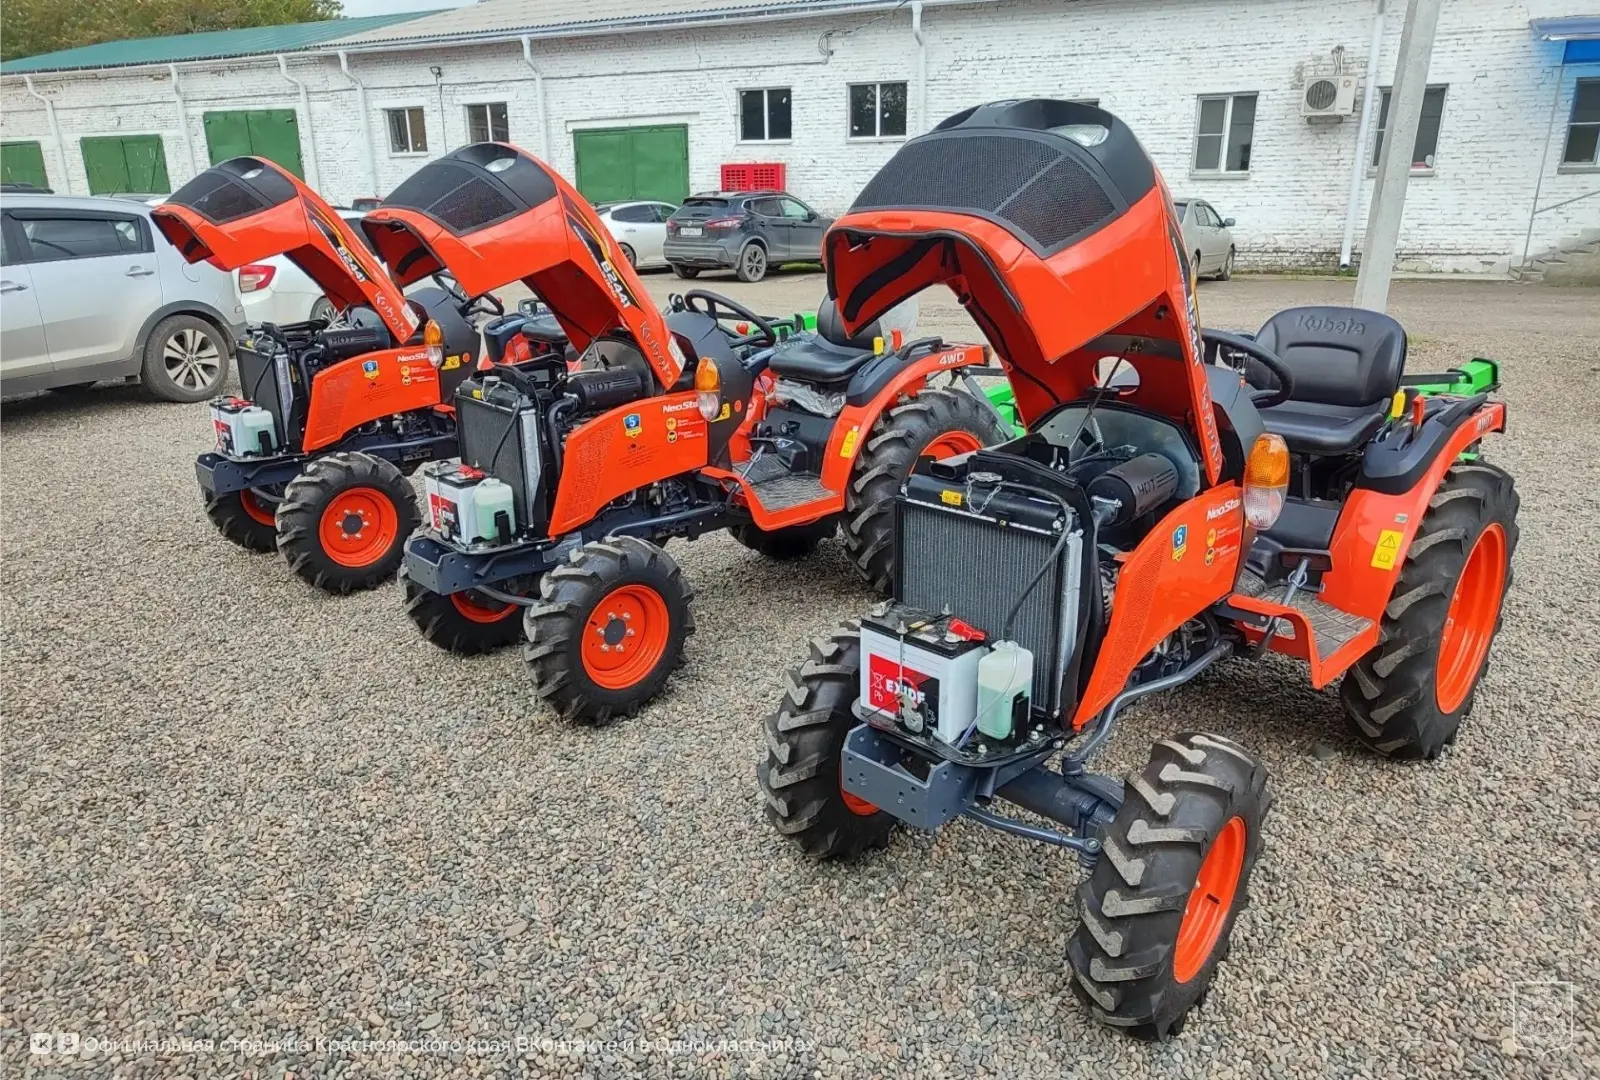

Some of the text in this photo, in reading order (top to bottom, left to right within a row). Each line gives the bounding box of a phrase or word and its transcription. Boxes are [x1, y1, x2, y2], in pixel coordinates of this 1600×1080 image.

[600, 260, 633, 309] B2441
[1297, 314, 1366, 335] Kubota
[397, 352, 428, 363] NeoSta
[639, 320, 675, 383] Kubota
[939, 351, 966, 365] 4WD
[588, 381, 612, 392] HOT
[662, 401, 699, 414] NeoSta
[1137, 479, 1157, 495] HOT
[1206, 498, 1241, 521] NeoSta
[1176, 528, 1183, 545] 5
[874, 689, 884, 702] Pb
[885, 679, 926, 704] EXIDE
